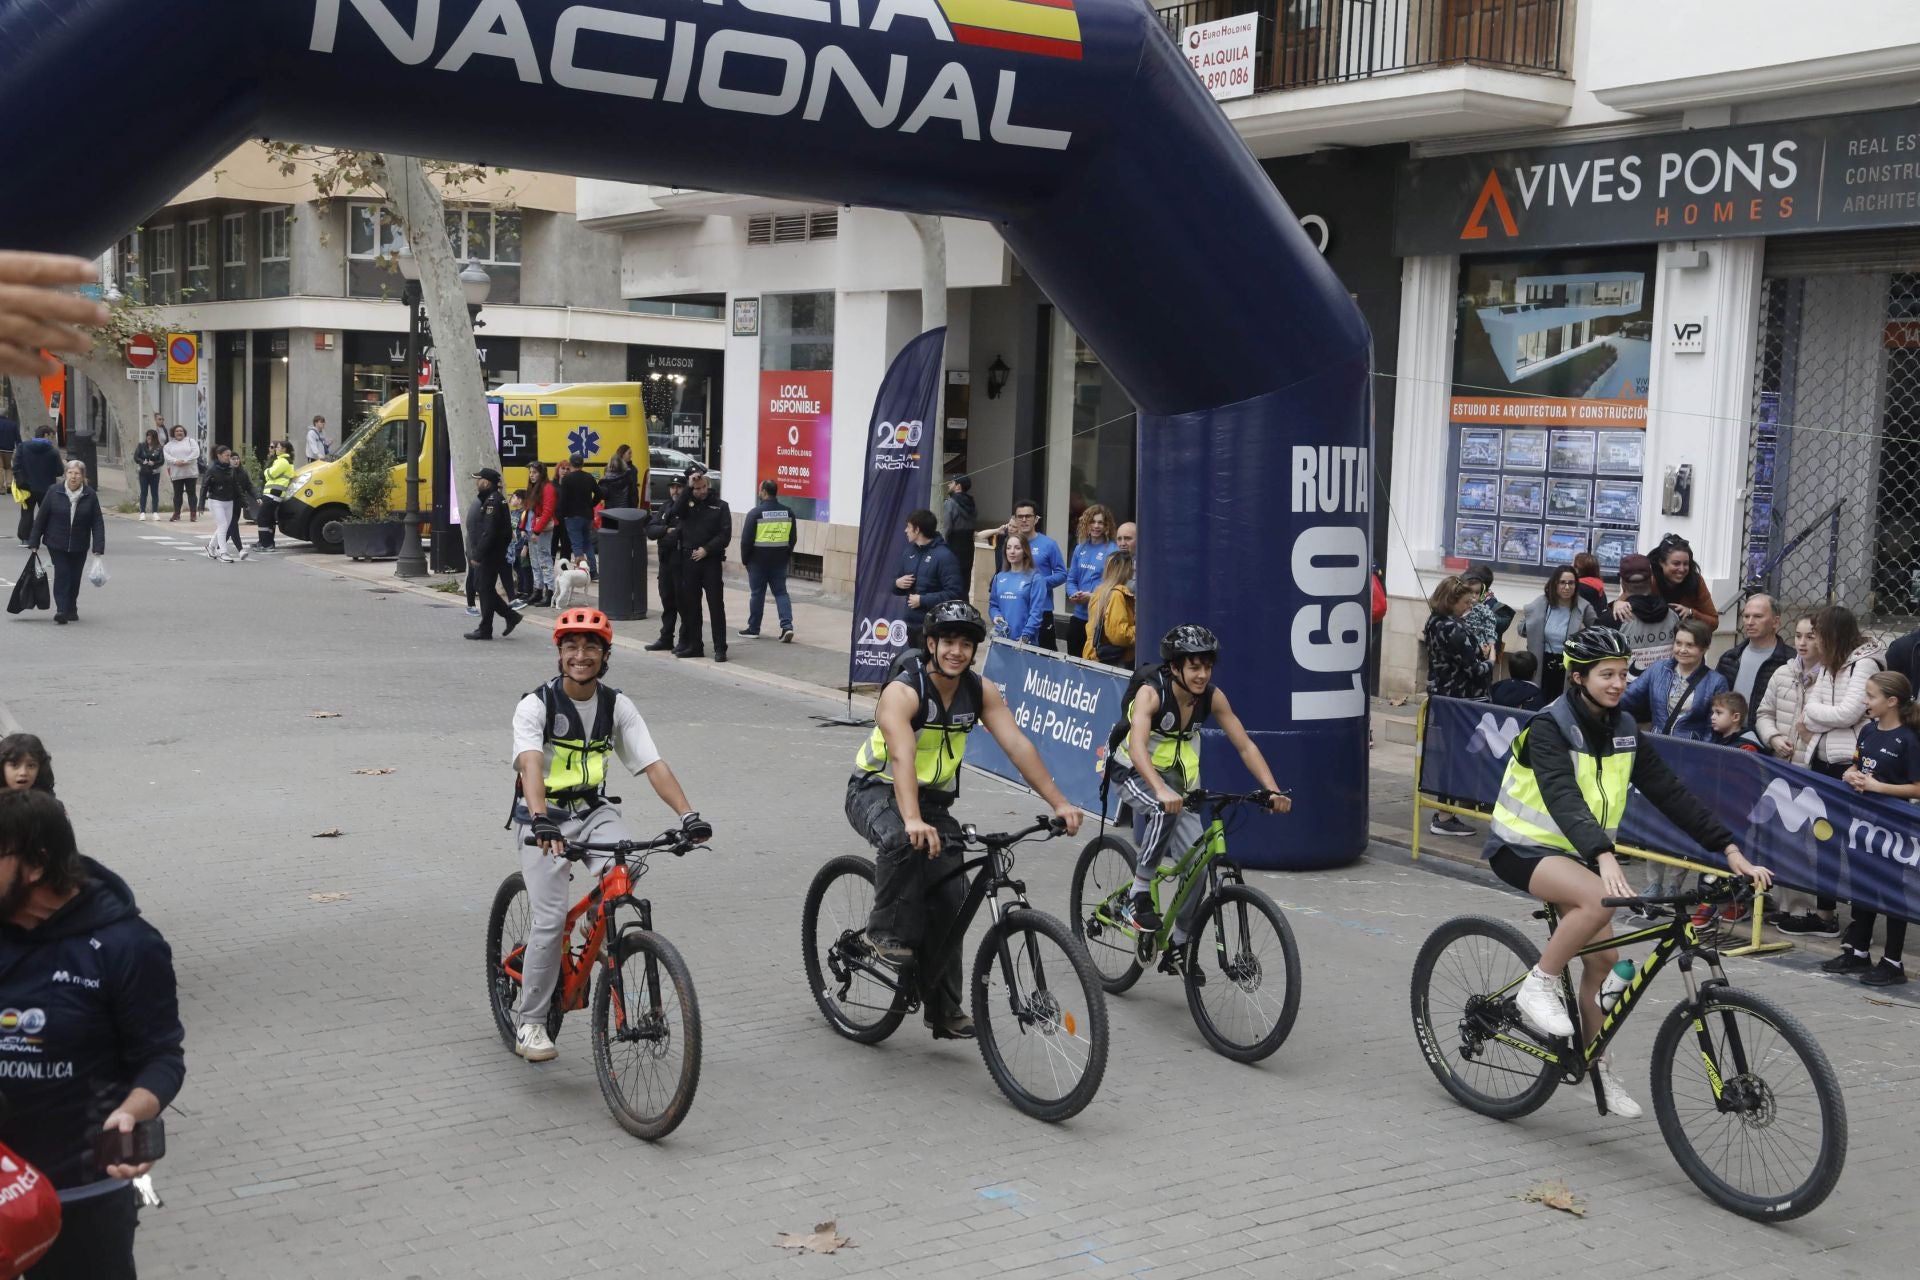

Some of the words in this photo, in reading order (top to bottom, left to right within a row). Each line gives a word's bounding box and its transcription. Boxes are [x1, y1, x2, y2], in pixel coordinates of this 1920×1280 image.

[1203, 46, 1249, 67] ALQUILA
[309, 0, 1072, 151] NACIONAL
[1208, 71, 1227, 89] 890
[1230, 67, 1248, 86] 086
[1849, 138, 1888, 156] REAL
[1896, 134, 1920, 151] ES
[1515, 155, 1642, 211] VIVES
[1659, 140, 1798, 198] PONS
[1655, 197, 1794, 226] HOMES
[1843, 192, 1920, 212] ARCHITE
[1673, 323, 1702, 340] VP
[658, 357, 694, 368] MACSON
[780, 385, 808, 398] LOCAL
[770, 400, 820, 414] DISPONIBLE
[1453, 404, 1487, 416] ESTUDIO
[1490, 405, 1500, 416] DE
[1503, 406, 1567, 419] ARQUITECTURA
[1571, 407, 1577, 418] Y
[674, 424, 700, 437] BLACK
[678, 436, 700, 448] BACK
[778, 465, 788, 475] 670
[789, 466, 799, 476] 890
[800, 467, 810, 477] 086
[1291, 446, 1369, 513] RUTA
[1024, 667, 1101, 714] Mutualidad
[1015, 701, 1031, 729] de
[1031, 705, 1043, 733] la
[1042, 709, 1094, 751] Policía
[1416, 1016, 1438, 1064] MAXXIS
